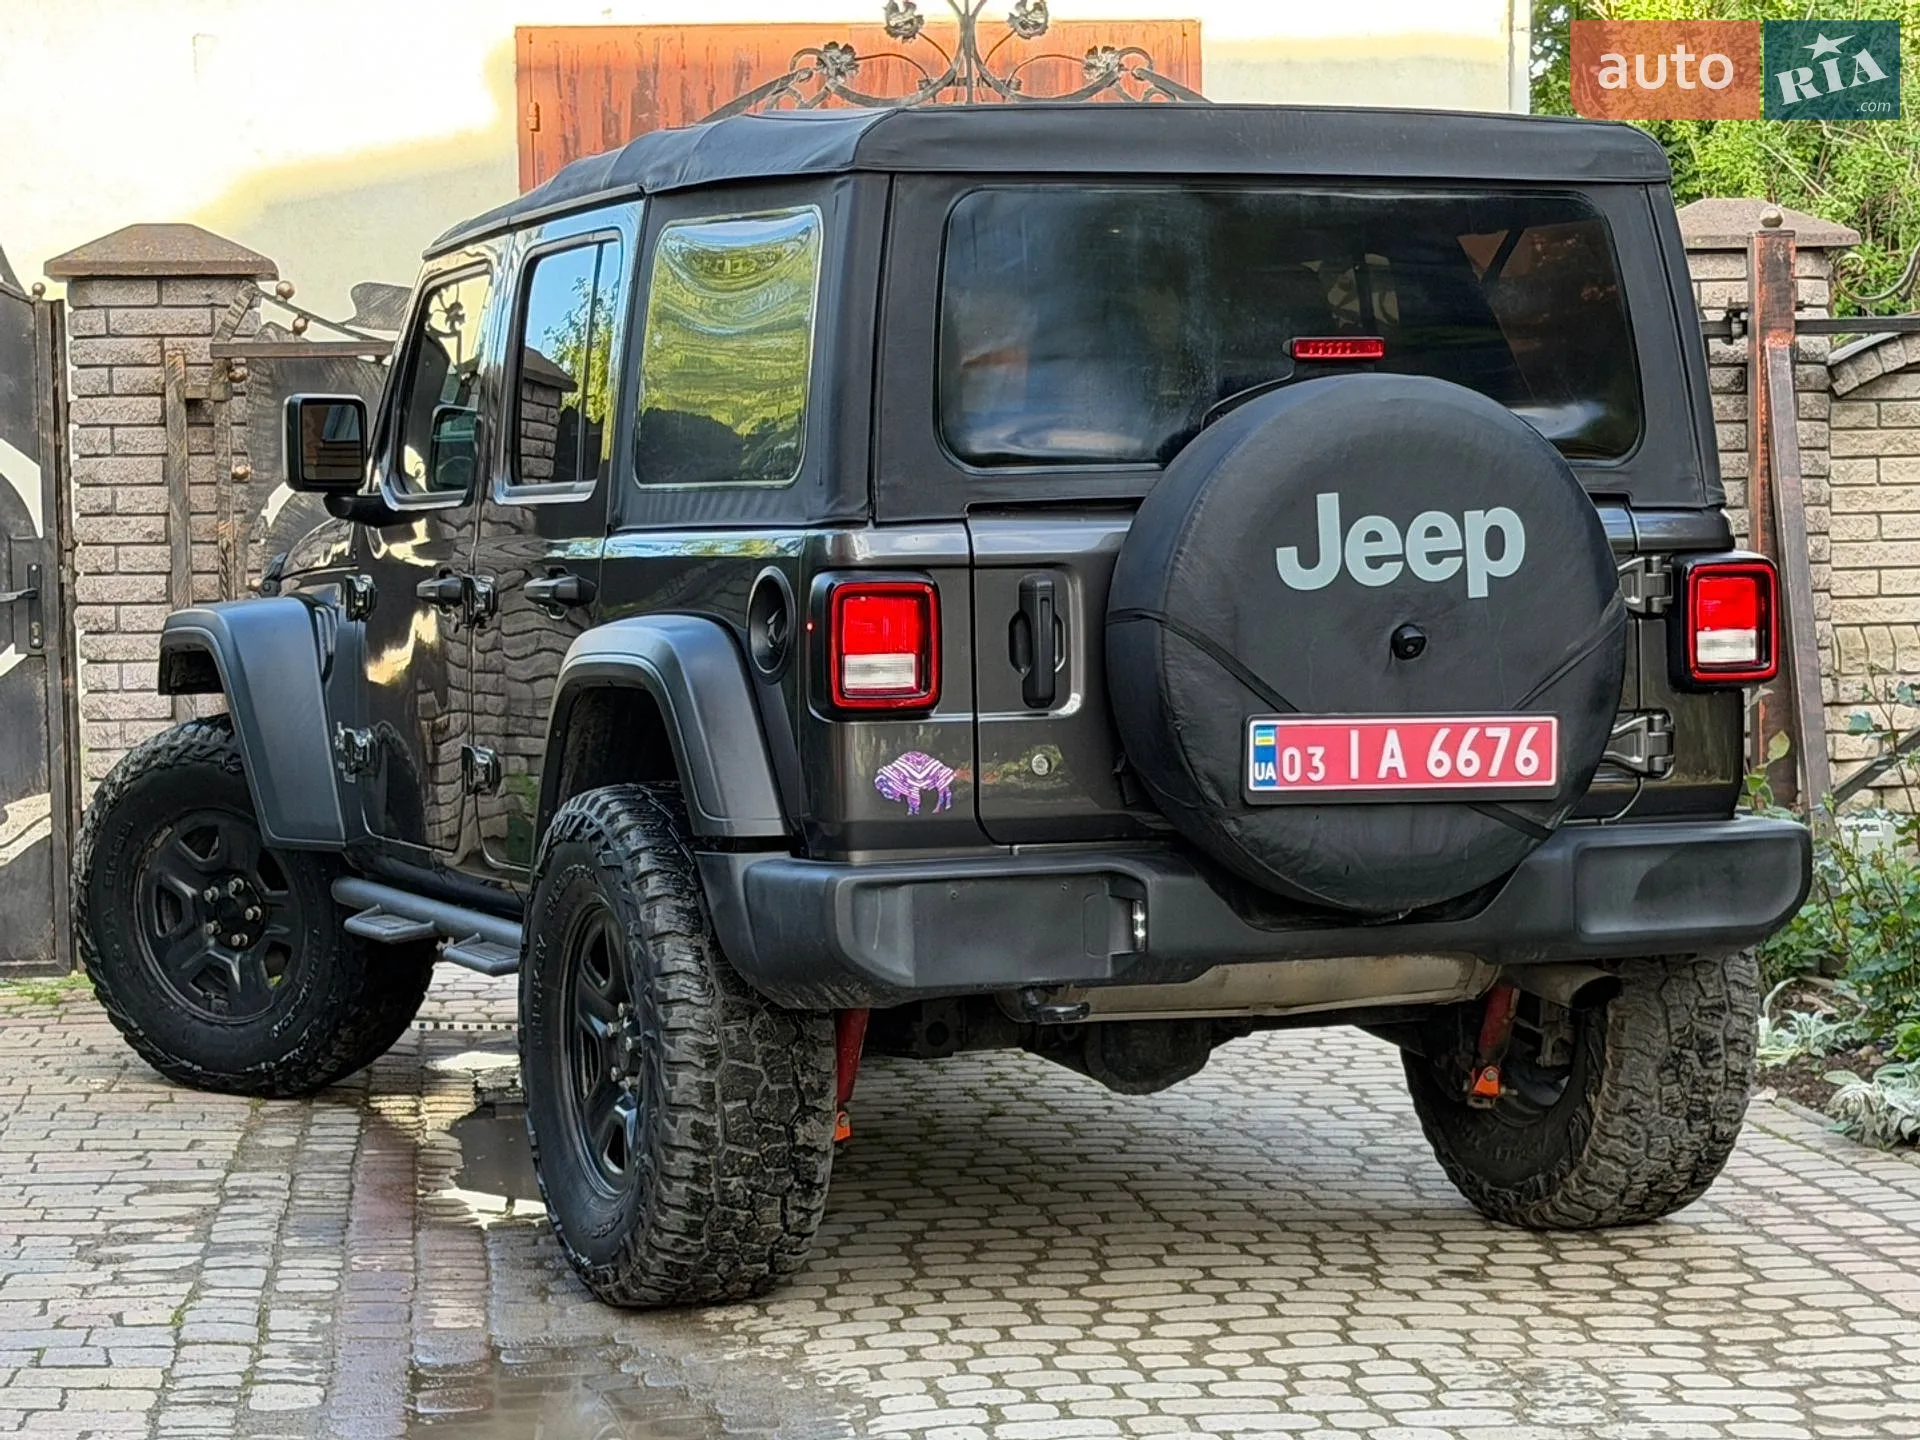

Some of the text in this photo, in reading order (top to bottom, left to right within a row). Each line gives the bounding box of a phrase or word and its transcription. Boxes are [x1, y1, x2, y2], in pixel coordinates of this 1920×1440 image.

[1276, 492, 1526, 598] Jeep
[1255, 762, 1276, 781] UA
[1282, 747, 1326, 782] 03
[1426, 727, 1540, 778] 6676
